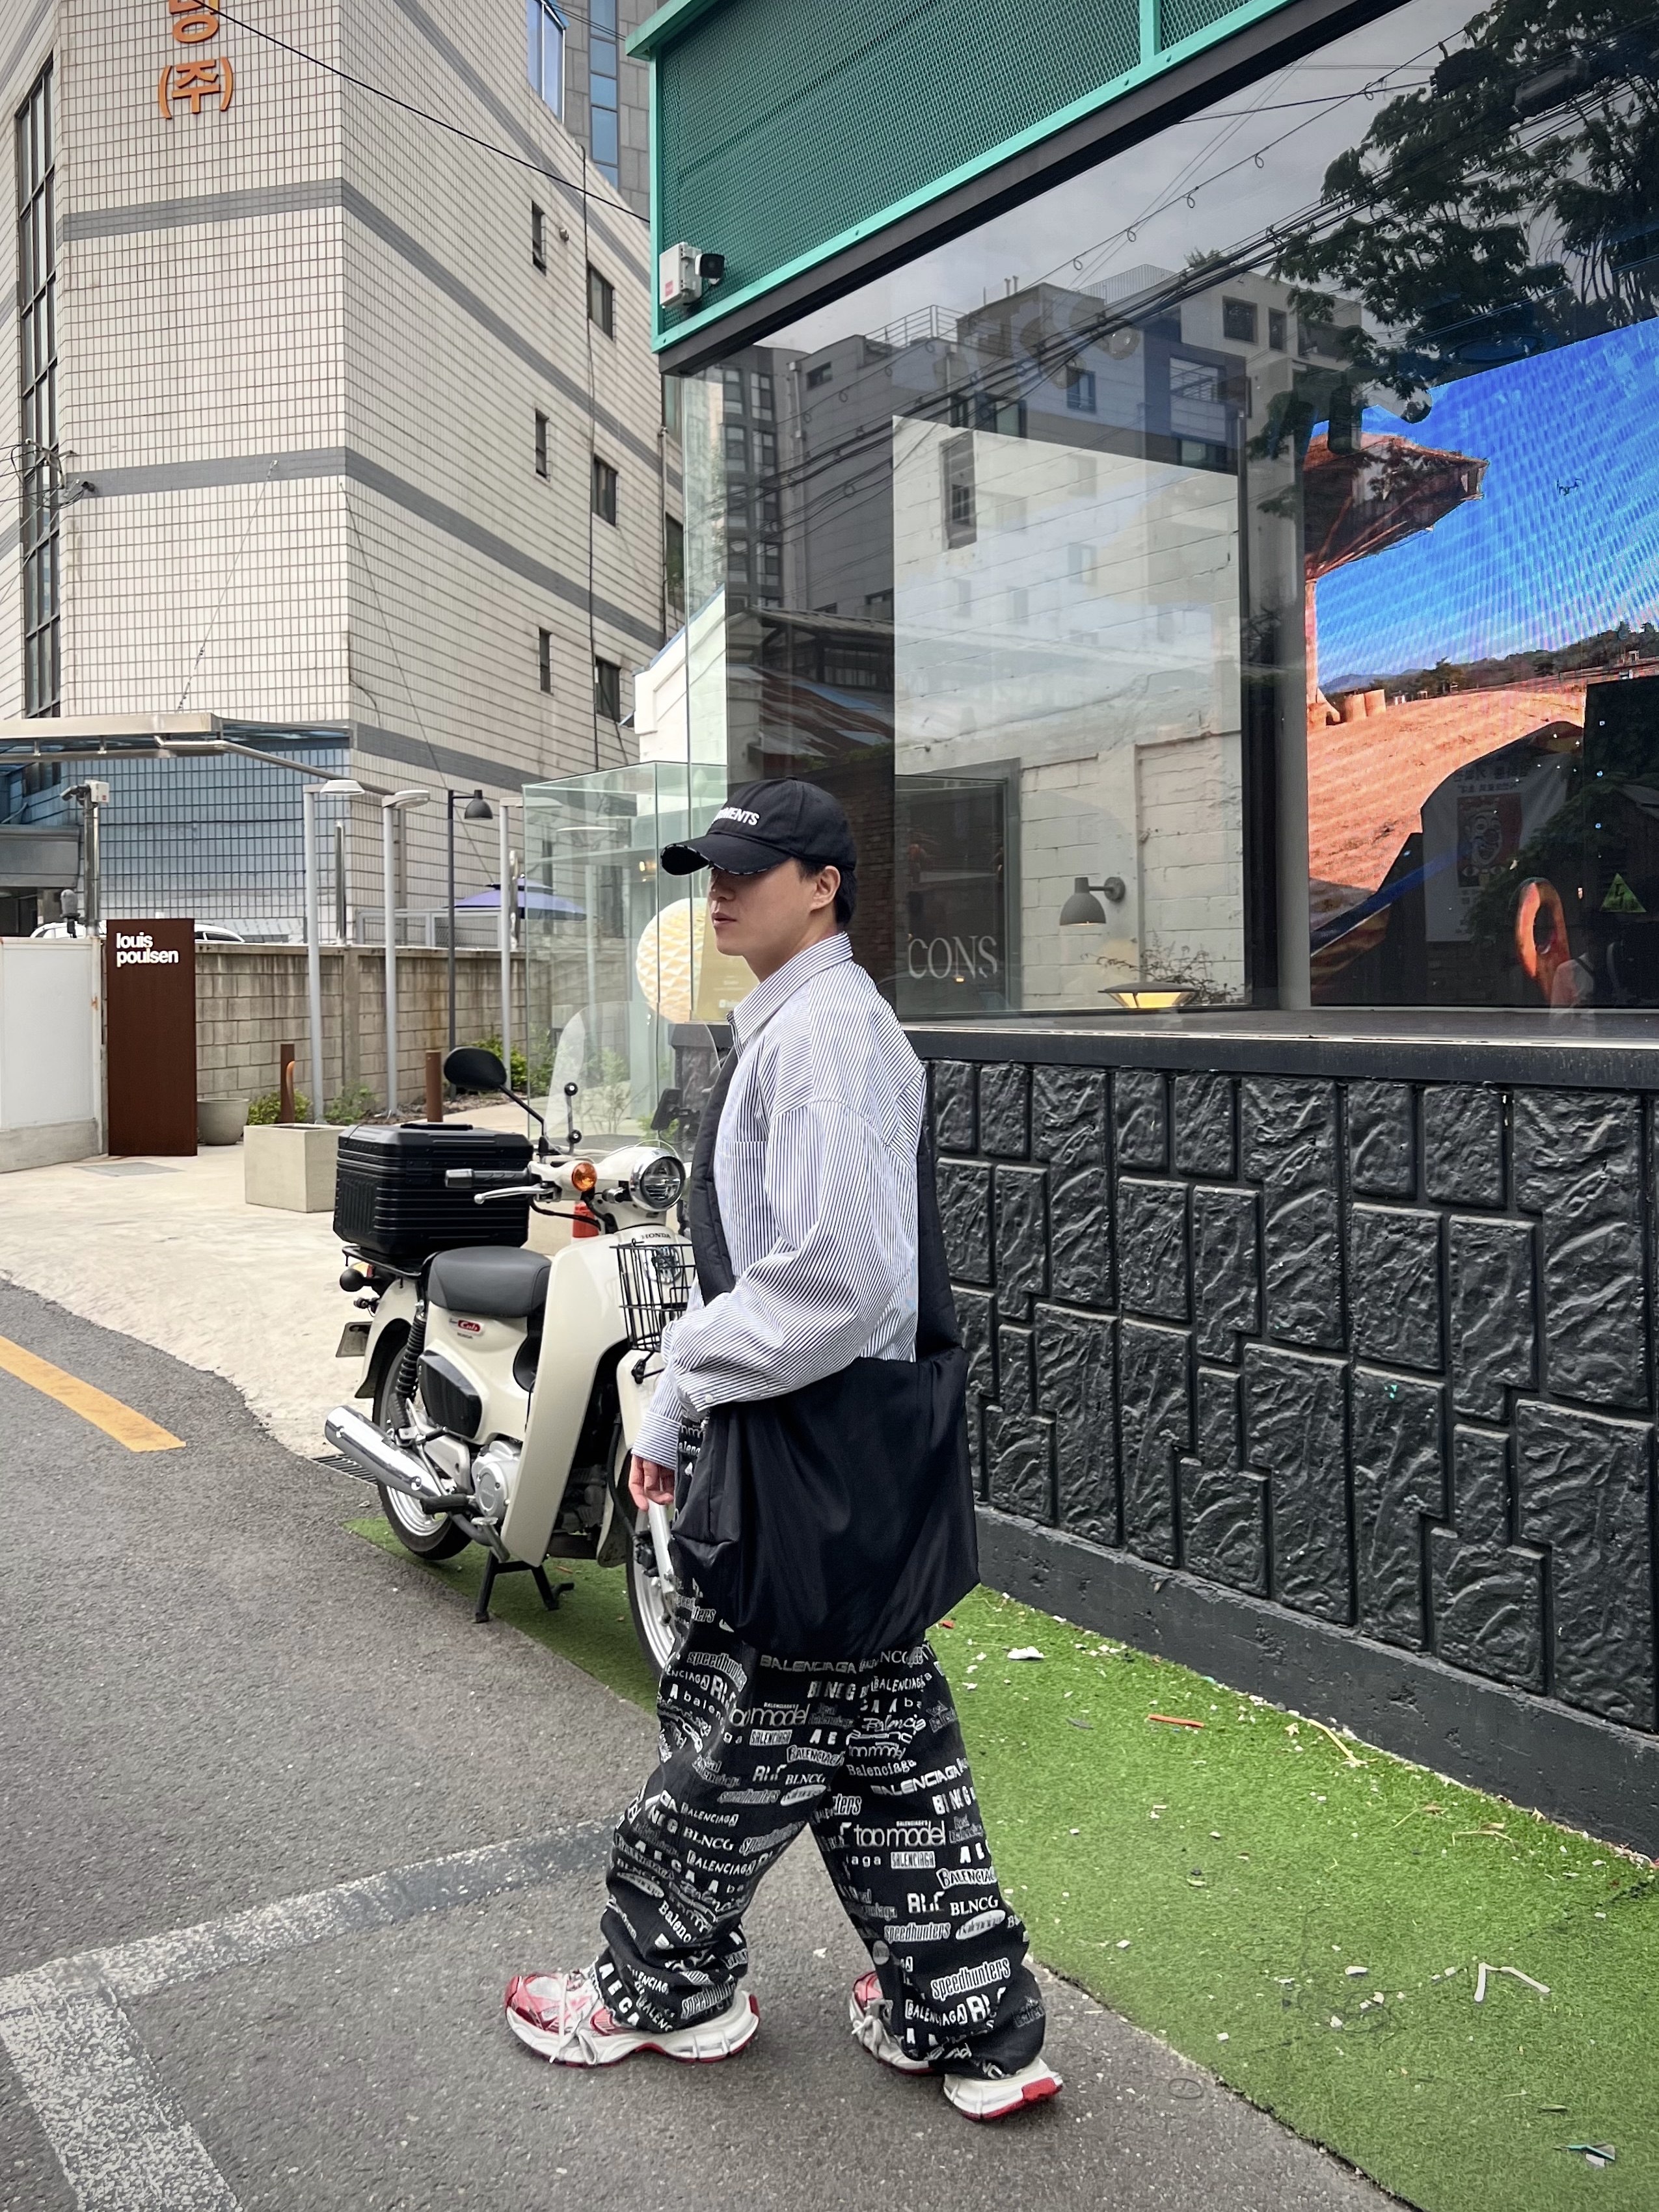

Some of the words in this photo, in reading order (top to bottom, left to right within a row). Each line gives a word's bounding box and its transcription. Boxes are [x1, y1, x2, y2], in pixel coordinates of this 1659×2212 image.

[158, 57, 234, 120] (주)
[116, 931, 154, 949] louis
[116, 947, 179, 968] poulsen
[908, 935, 997, 979] CONS
[683, 1826, 734, 1851] BLNCG
[936, 1867, 997, 1889] BALENCIAG
[950, 1895, 998, 1916] BLNCG
[884, 1922, 952, 1945] speedhunters
[930, 1957, 1011, 2001] speedhunters
